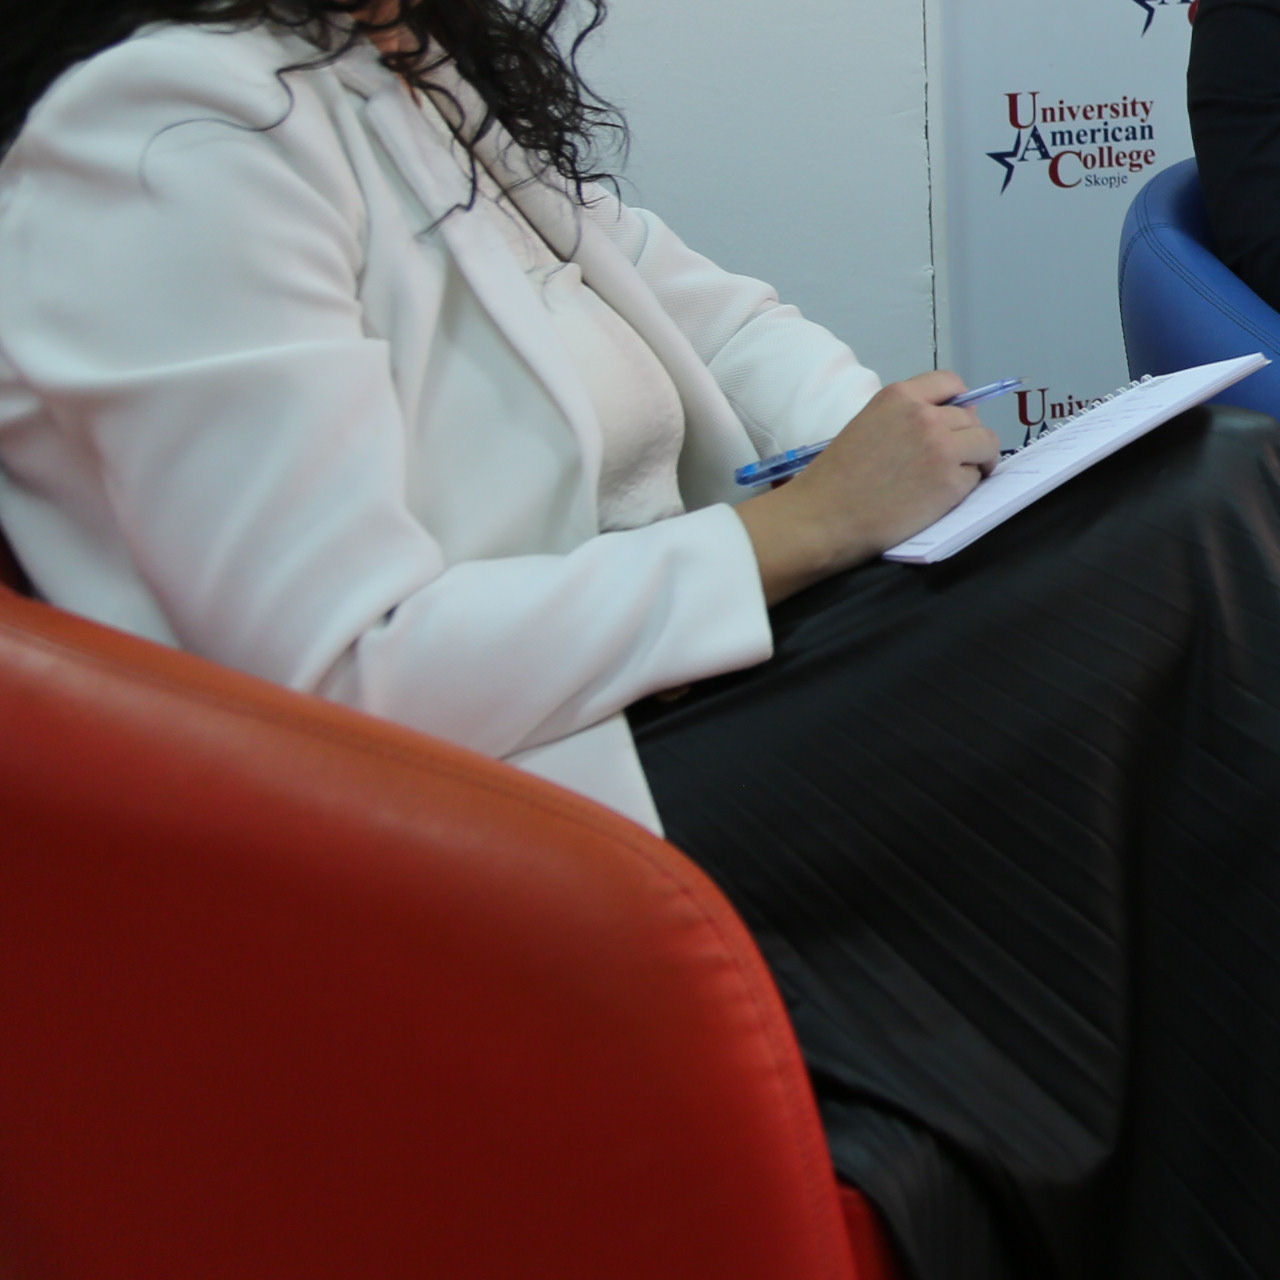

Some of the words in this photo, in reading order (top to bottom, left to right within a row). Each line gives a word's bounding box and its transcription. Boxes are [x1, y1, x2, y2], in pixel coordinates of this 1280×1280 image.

[1004, 92, 1154, 129] University
[1018, 122, 1154, 161] American
[1049, 146, 1155, 188] College
[1085, 174, 1128, 188] Skopje
